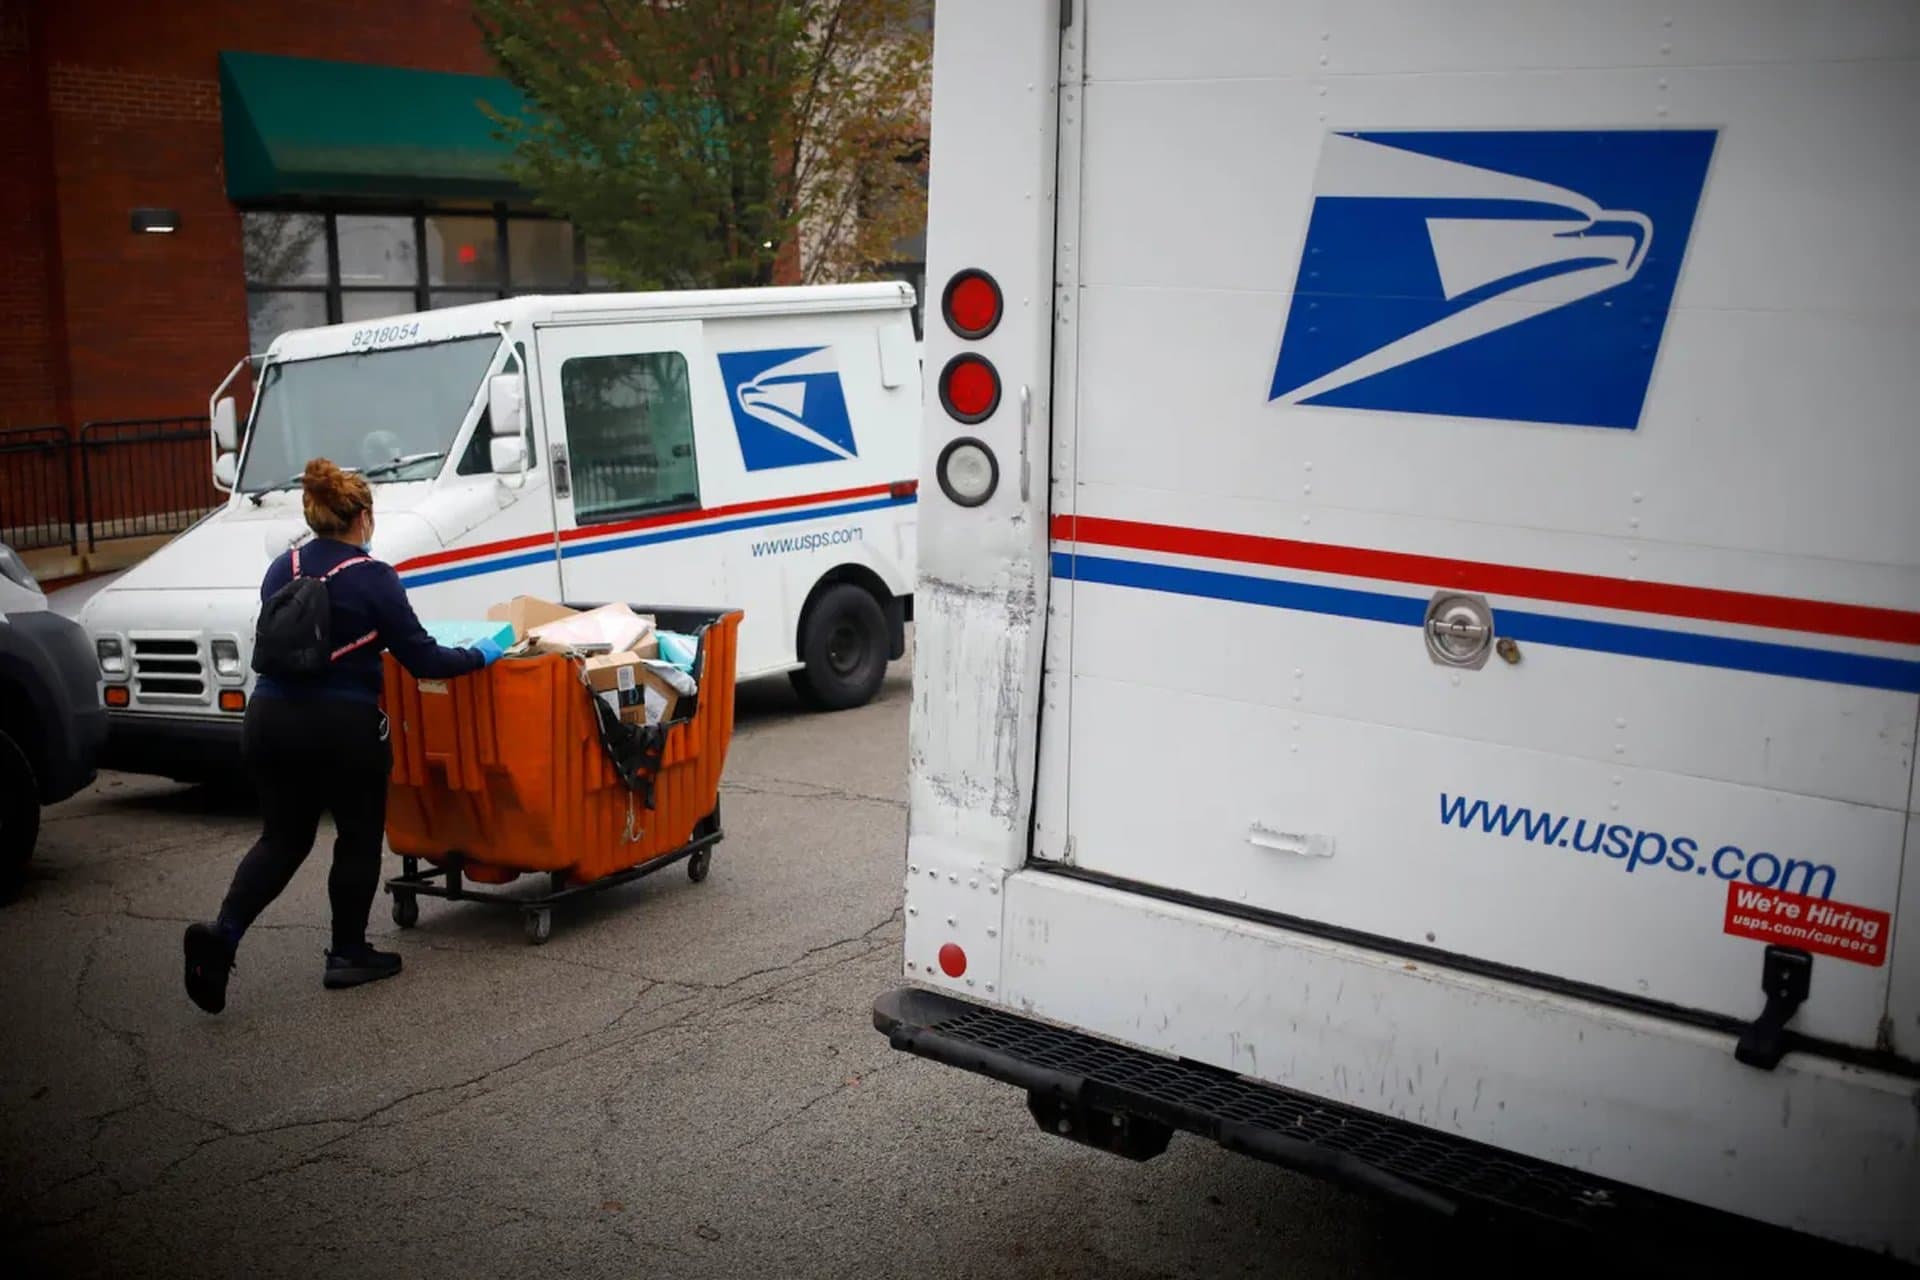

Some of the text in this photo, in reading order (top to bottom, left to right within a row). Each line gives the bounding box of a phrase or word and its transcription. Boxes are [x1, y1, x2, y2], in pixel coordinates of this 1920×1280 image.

[352, 322, 420, 346] 8218054
[751, 527, 863, 557] www.usps.com
[1440, 792, 1836, 900] www.usps.com
[1737, 888, 1880, 939] We're Hiring
[1733, 914, 1877, 953] usps.com/careers
